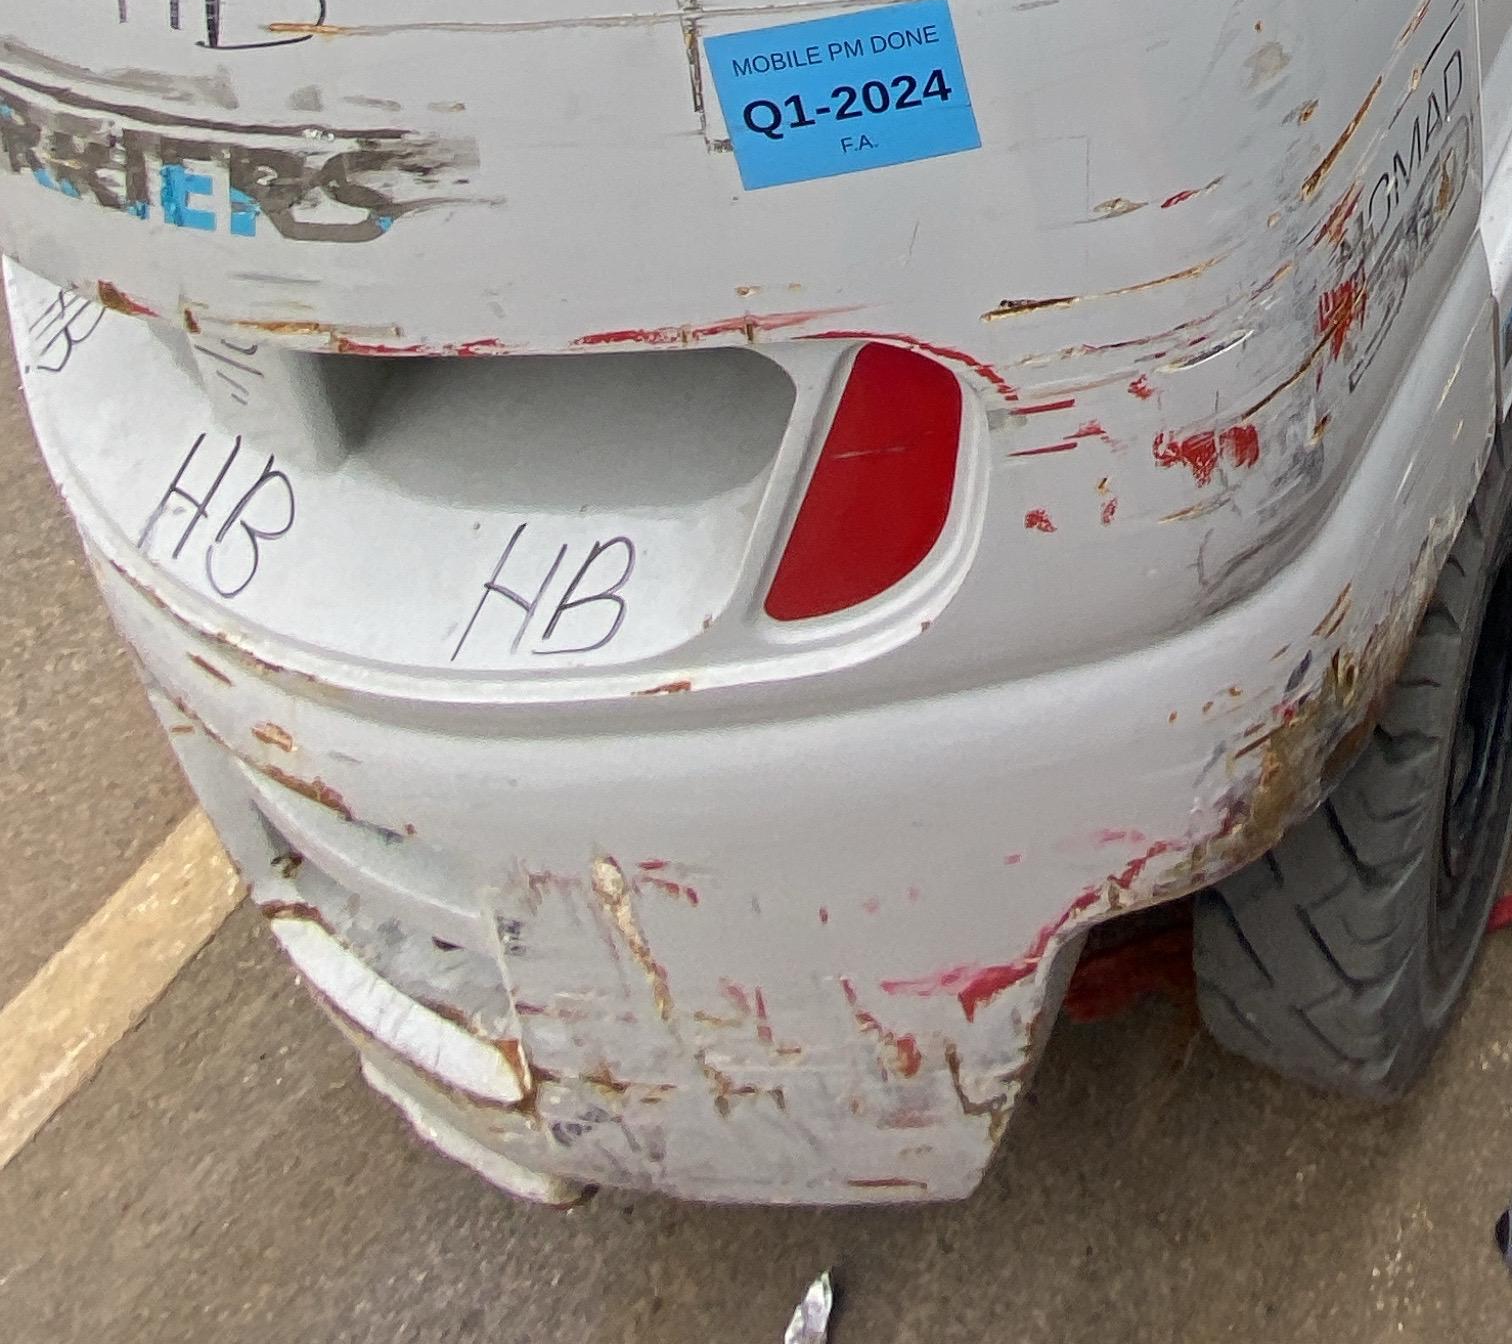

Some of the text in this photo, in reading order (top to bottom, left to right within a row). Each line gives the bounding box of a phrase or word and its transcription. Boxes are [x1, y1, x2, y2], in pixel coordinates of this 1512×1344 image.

[732, 25, 939, 77] MOBILE PM DONE
[743, 69, 952, 140] Q1-2024
[138, 432, 295, 598] HB
[452, 523, 635, 661] HB
